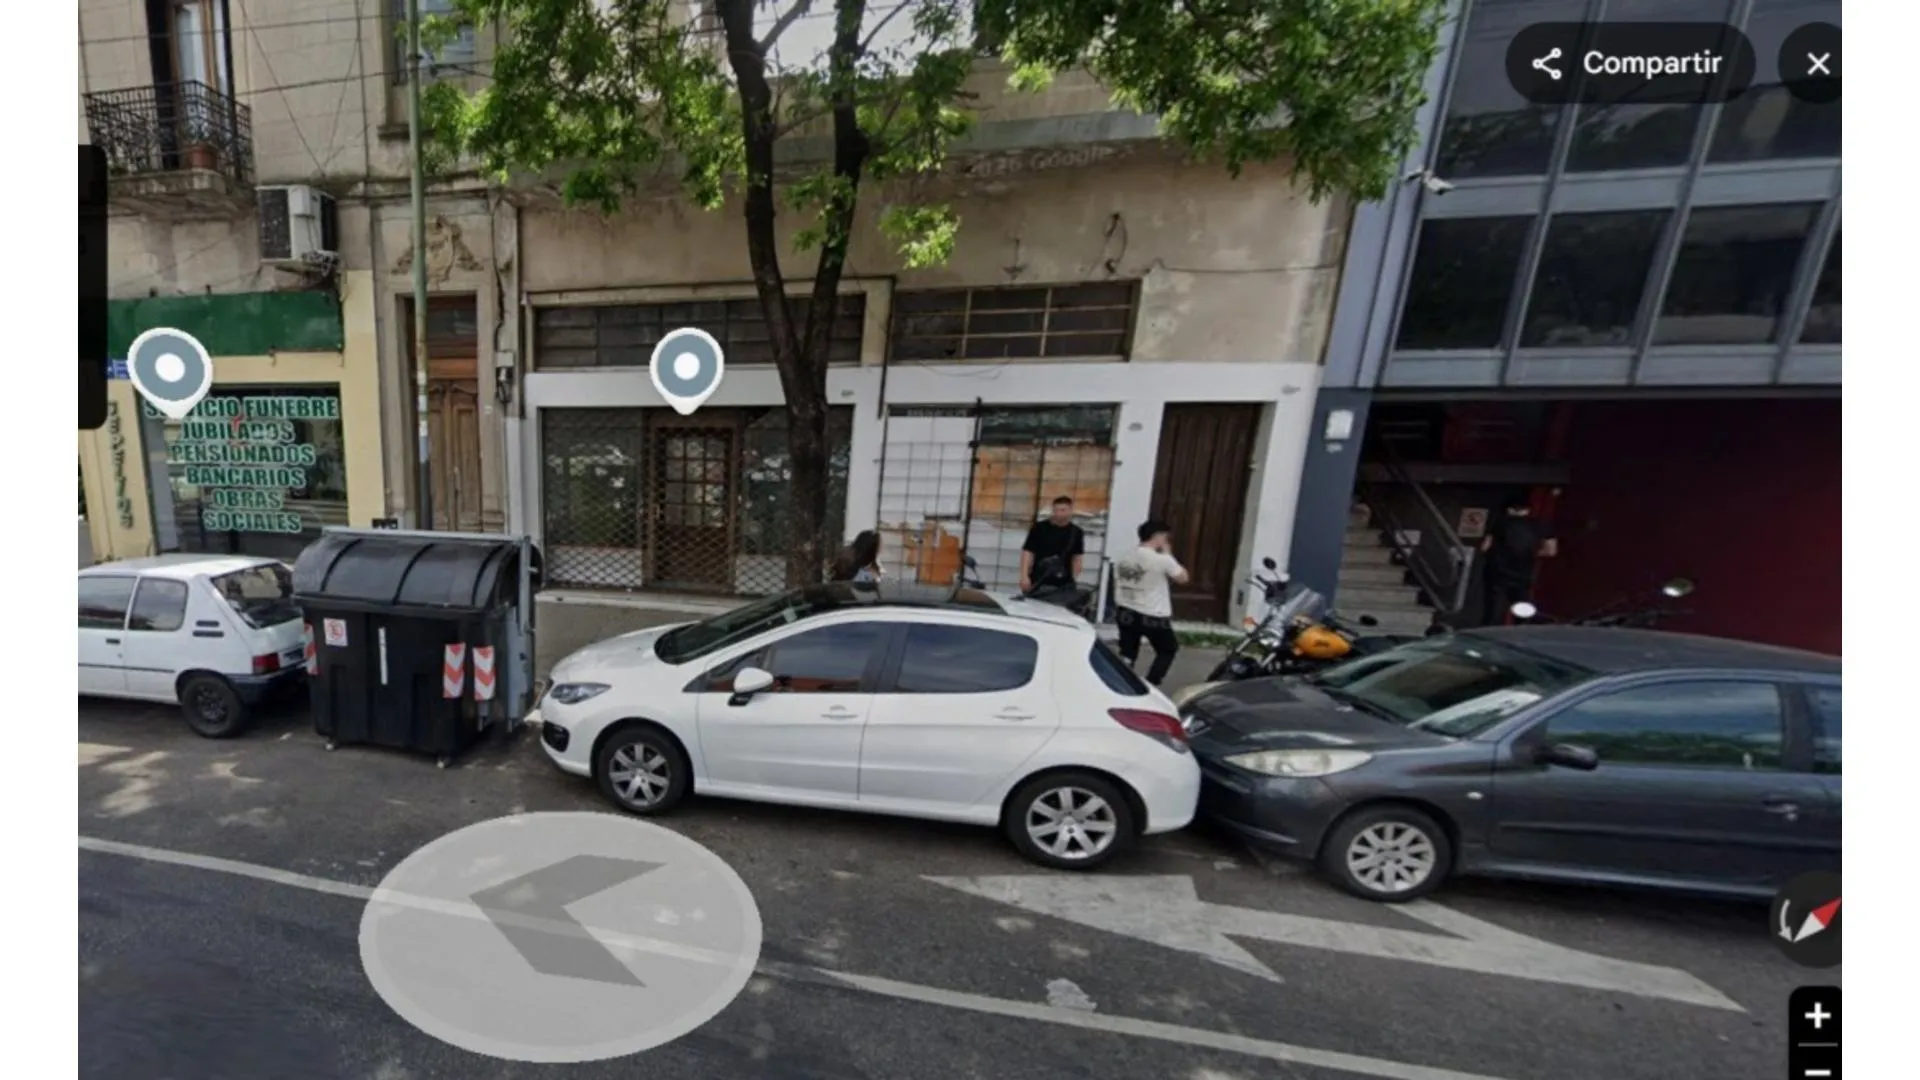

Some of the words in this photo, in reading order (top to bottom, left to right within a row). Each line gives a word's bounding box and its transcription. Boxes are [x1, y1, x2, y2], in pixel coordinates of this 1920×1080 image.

[144, 397, 240, 418] SICIO
[243, 397, 338, 418] FUNEBRE
[181, 421, 295, 441] JUBILADOS
[170, 443, 315, 465] PENSIONADOS
[185, 466, 305, 487] BANCARIOS
[214, 489, 282, 509] OBRAS
[203, 511, 301, 533] SOCIALES
